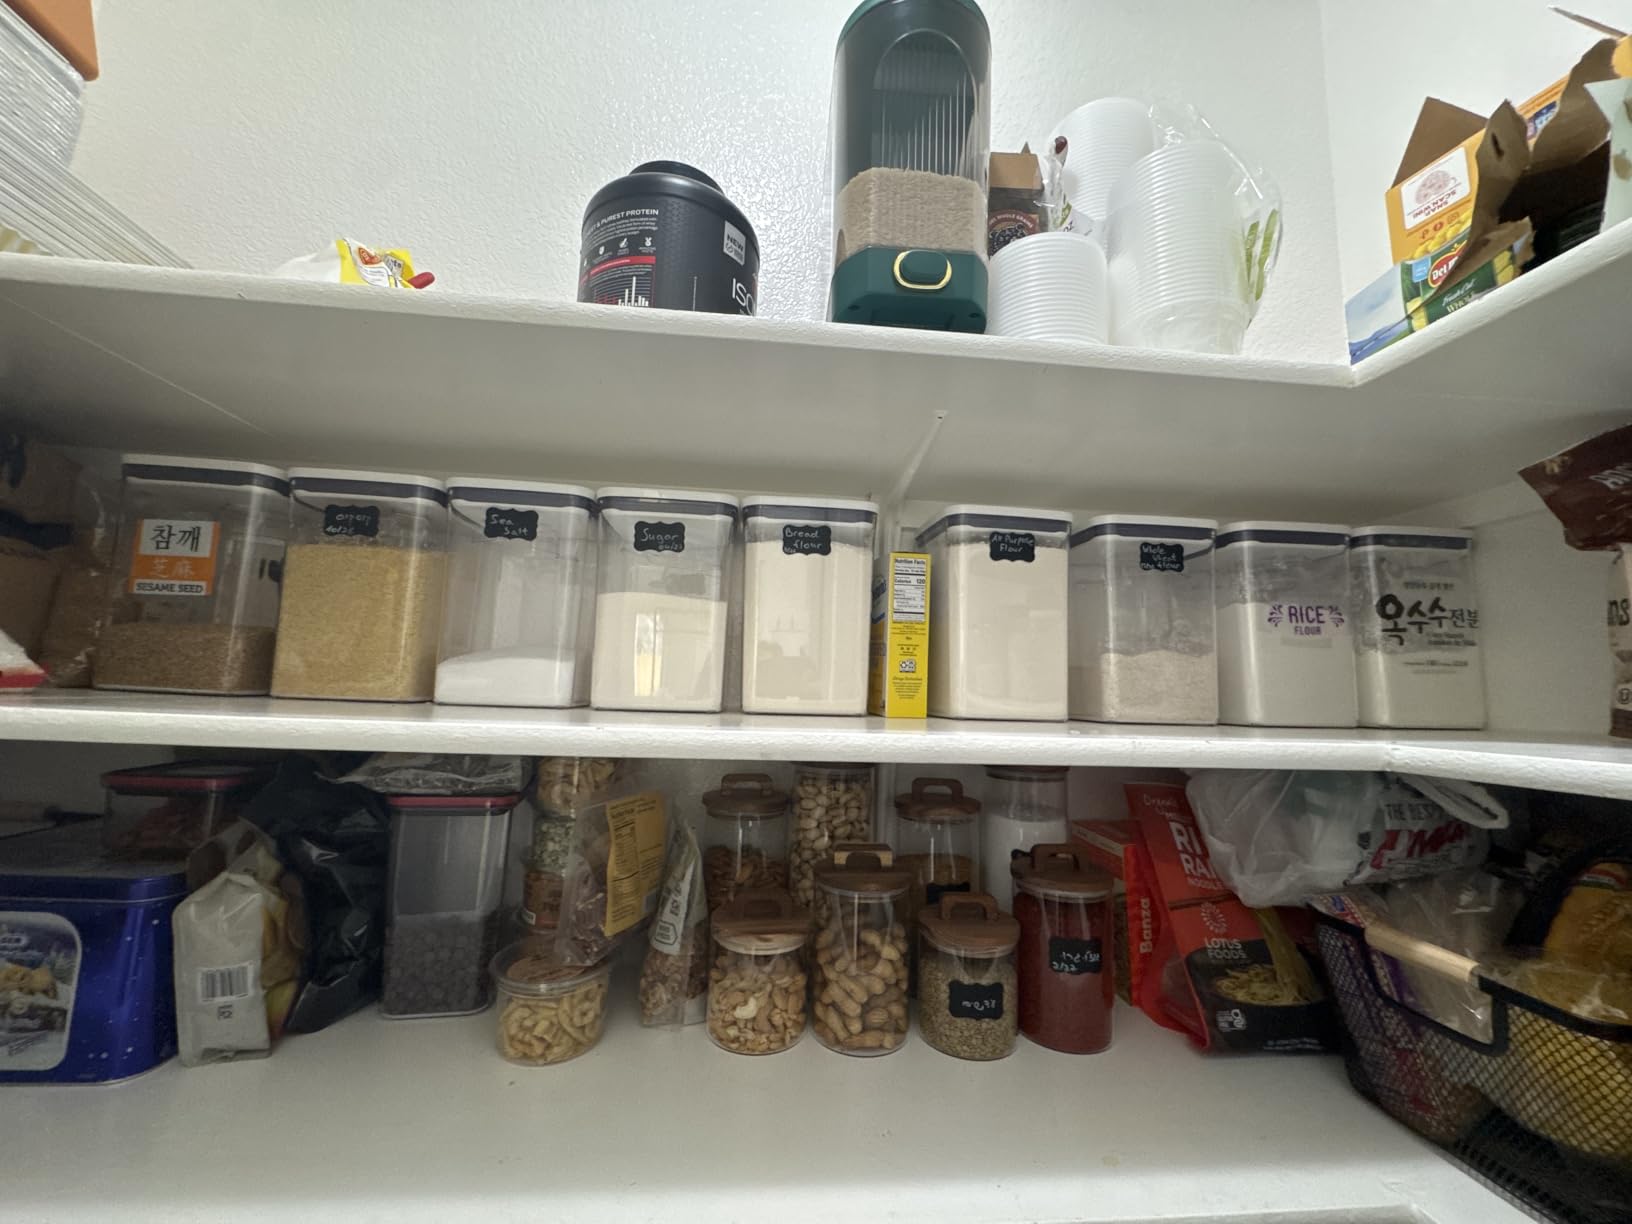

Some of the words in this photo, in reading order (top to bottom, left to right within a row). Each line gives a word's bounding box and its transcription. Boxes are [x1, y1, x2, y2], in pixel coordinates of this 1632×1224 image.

[626, 208, 659, 217] PROTEIN
[726, 232, 744, 253] NEW
[1431, 264, 1448, 281] Del
[490, 514, 514, 525] Sea
[504, 526, 528, 536] Salt
[641, 527, 680, 545] Sugar
[785, 526, 820, 538] Bread
[150, 524, 202, 552] 참깨
[793, 539, 822, 550] flour
[1000, 543, 1024, 553] Flour
[1142, 544, 1166, 554] Whole
[136, 582, 176, 592] SESAME
[178, 584, 203, 593] SEED
[1288, 605, 1326, 624] RICE
[1294, 625, 1321, 635] FLOUR
[1139, 897, 1153, 955] Banza
[1204, 937, 1243, 950] LOTUS
[1207, 948, 1248, 960] FOODS
